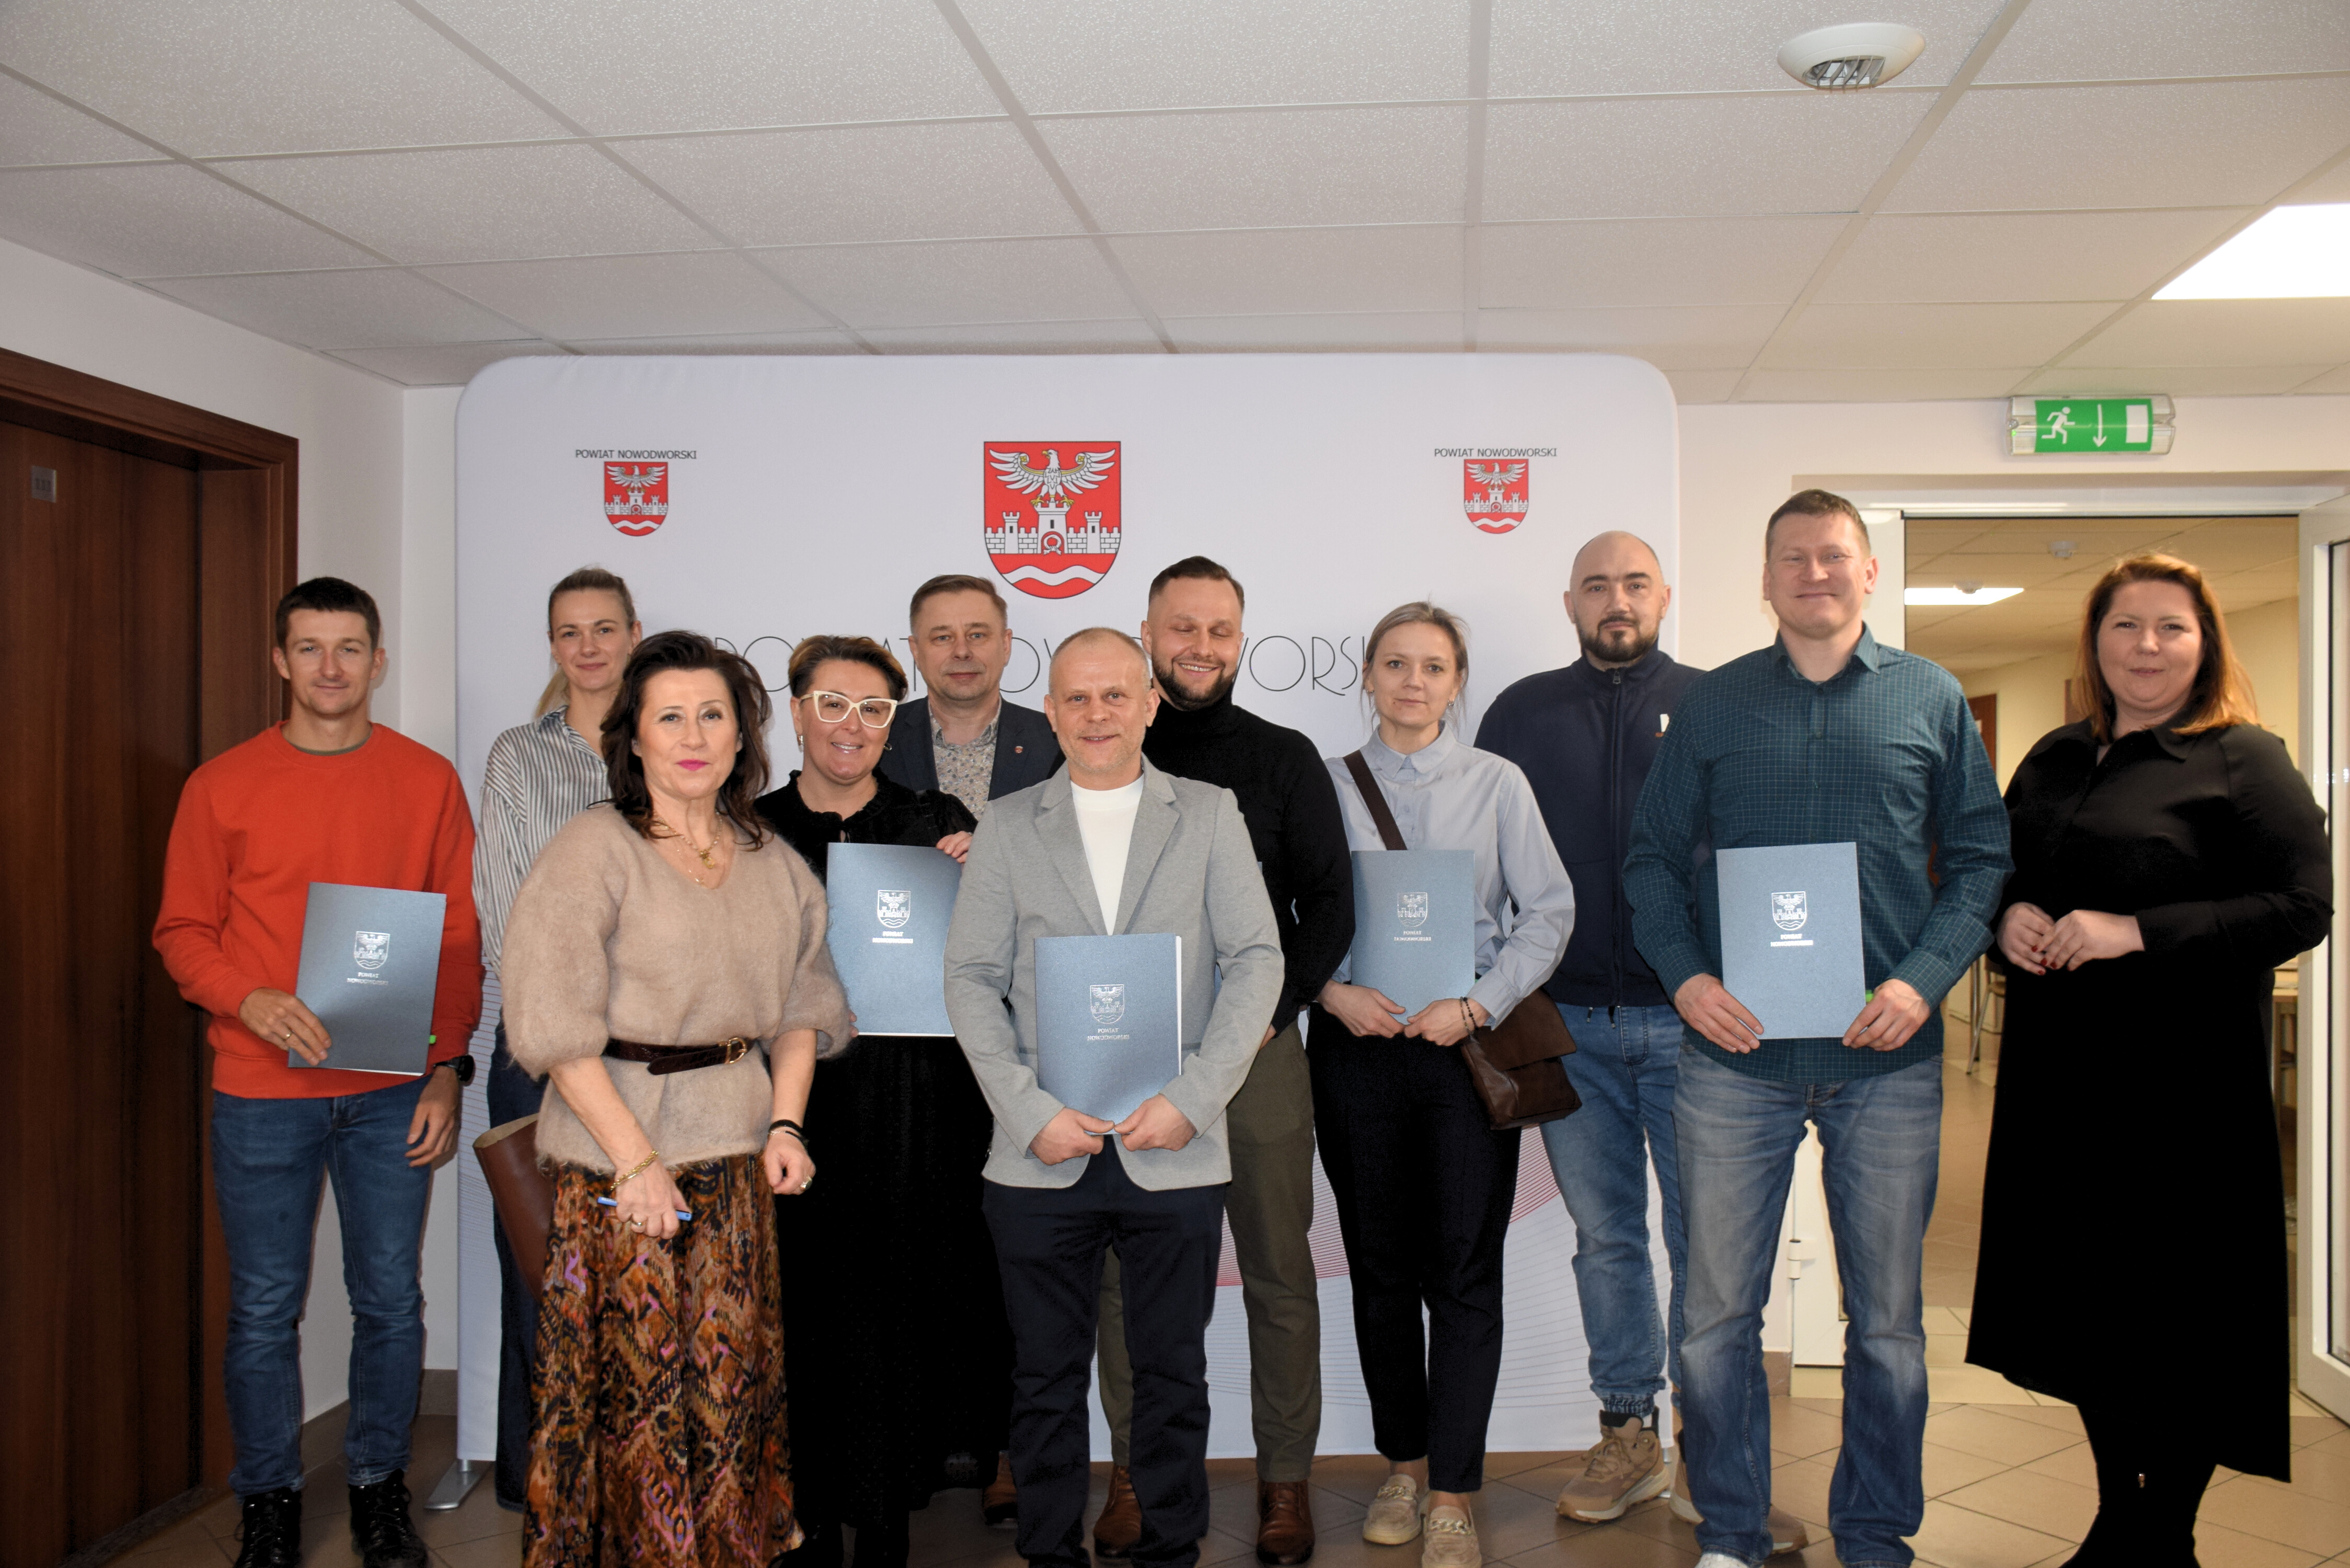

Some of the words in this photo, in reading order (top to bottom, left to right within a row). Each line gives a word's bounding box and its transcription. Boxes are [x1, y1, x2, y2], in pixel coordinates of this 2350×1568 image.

[575, 449, 614, 458] POWIAT
[618, 449, 697, 459] NOWODWORSKI
[1434, 448, 1474, 457] POWIAT
[1477, 448, 1557, 457] NOWODWORSKI
